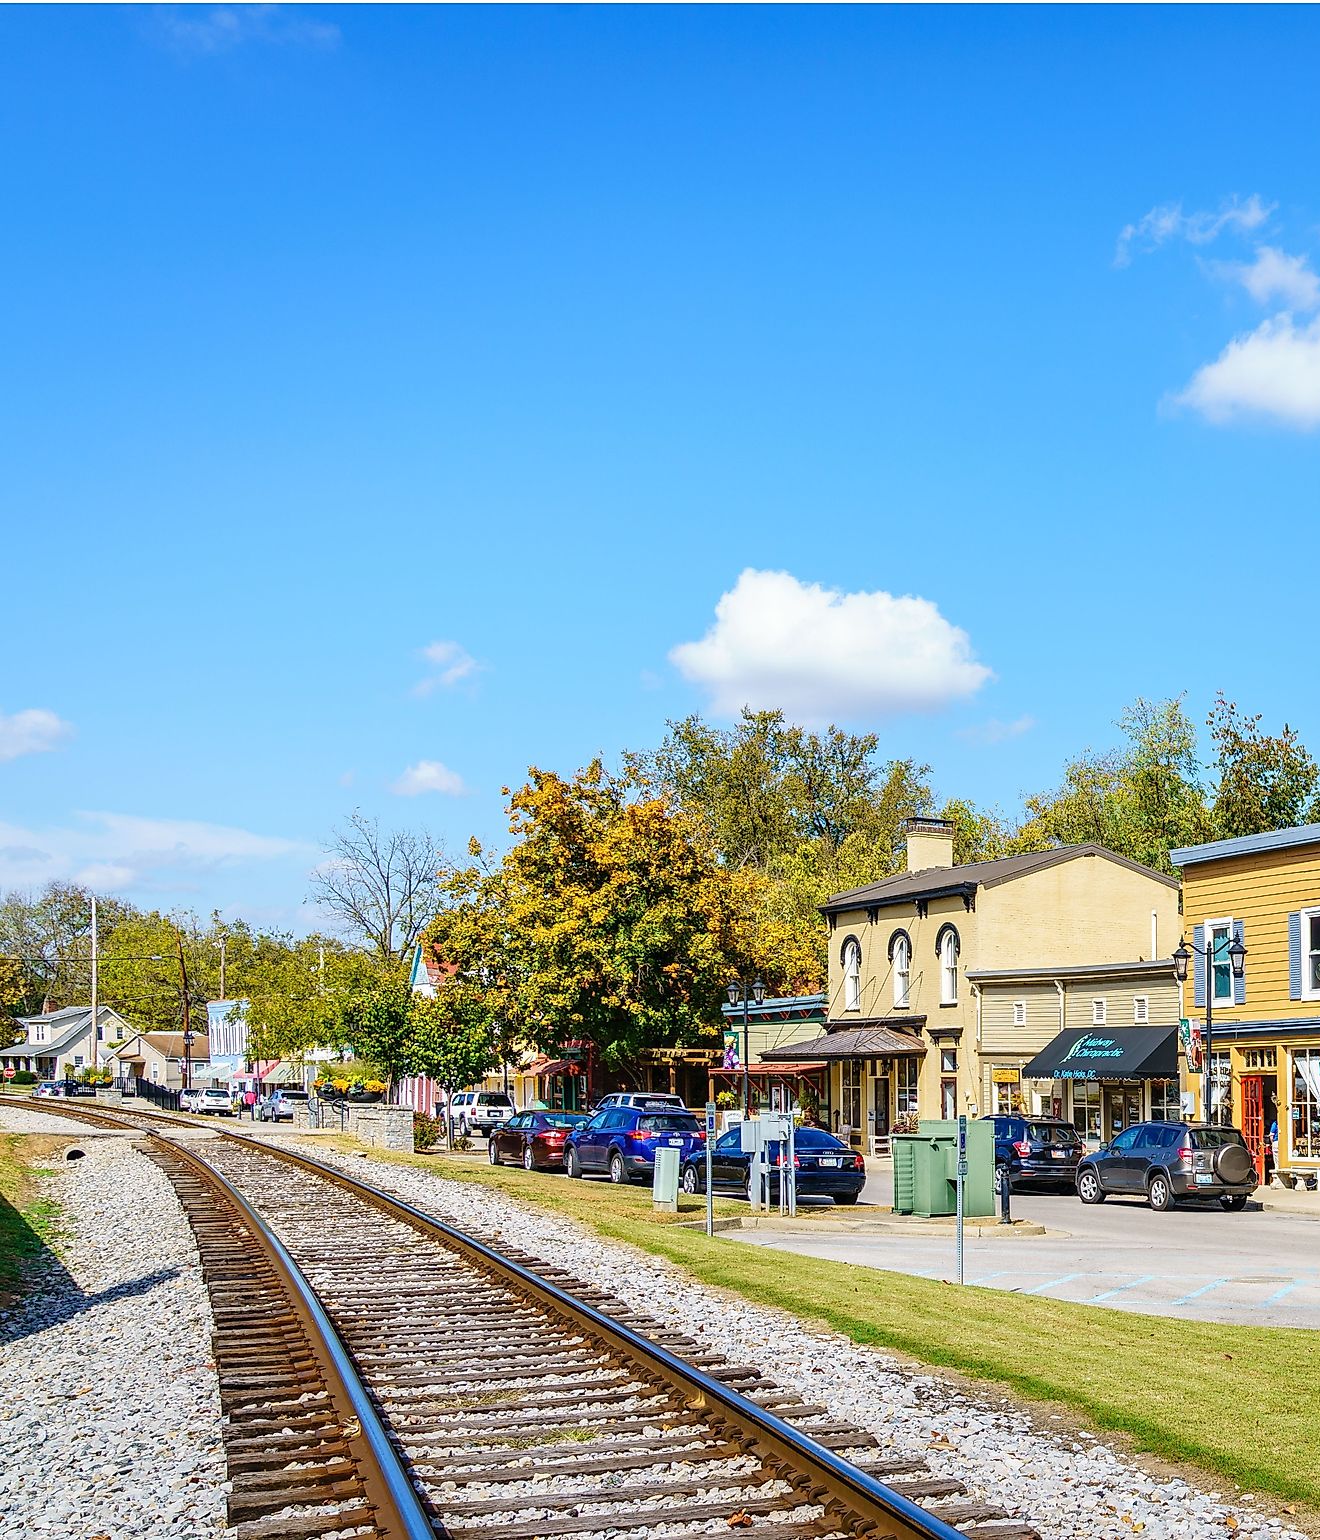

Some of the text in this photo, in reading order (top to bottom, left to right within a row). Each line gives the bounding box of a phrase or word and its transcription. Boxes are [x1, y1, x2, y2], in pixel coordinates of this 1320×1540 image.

[1082, 1038, 1116, 1048] Midway
[1076, 1047, 1124, 1058] Chiropractic
[1087, 1070, 1096, 1078] DC
